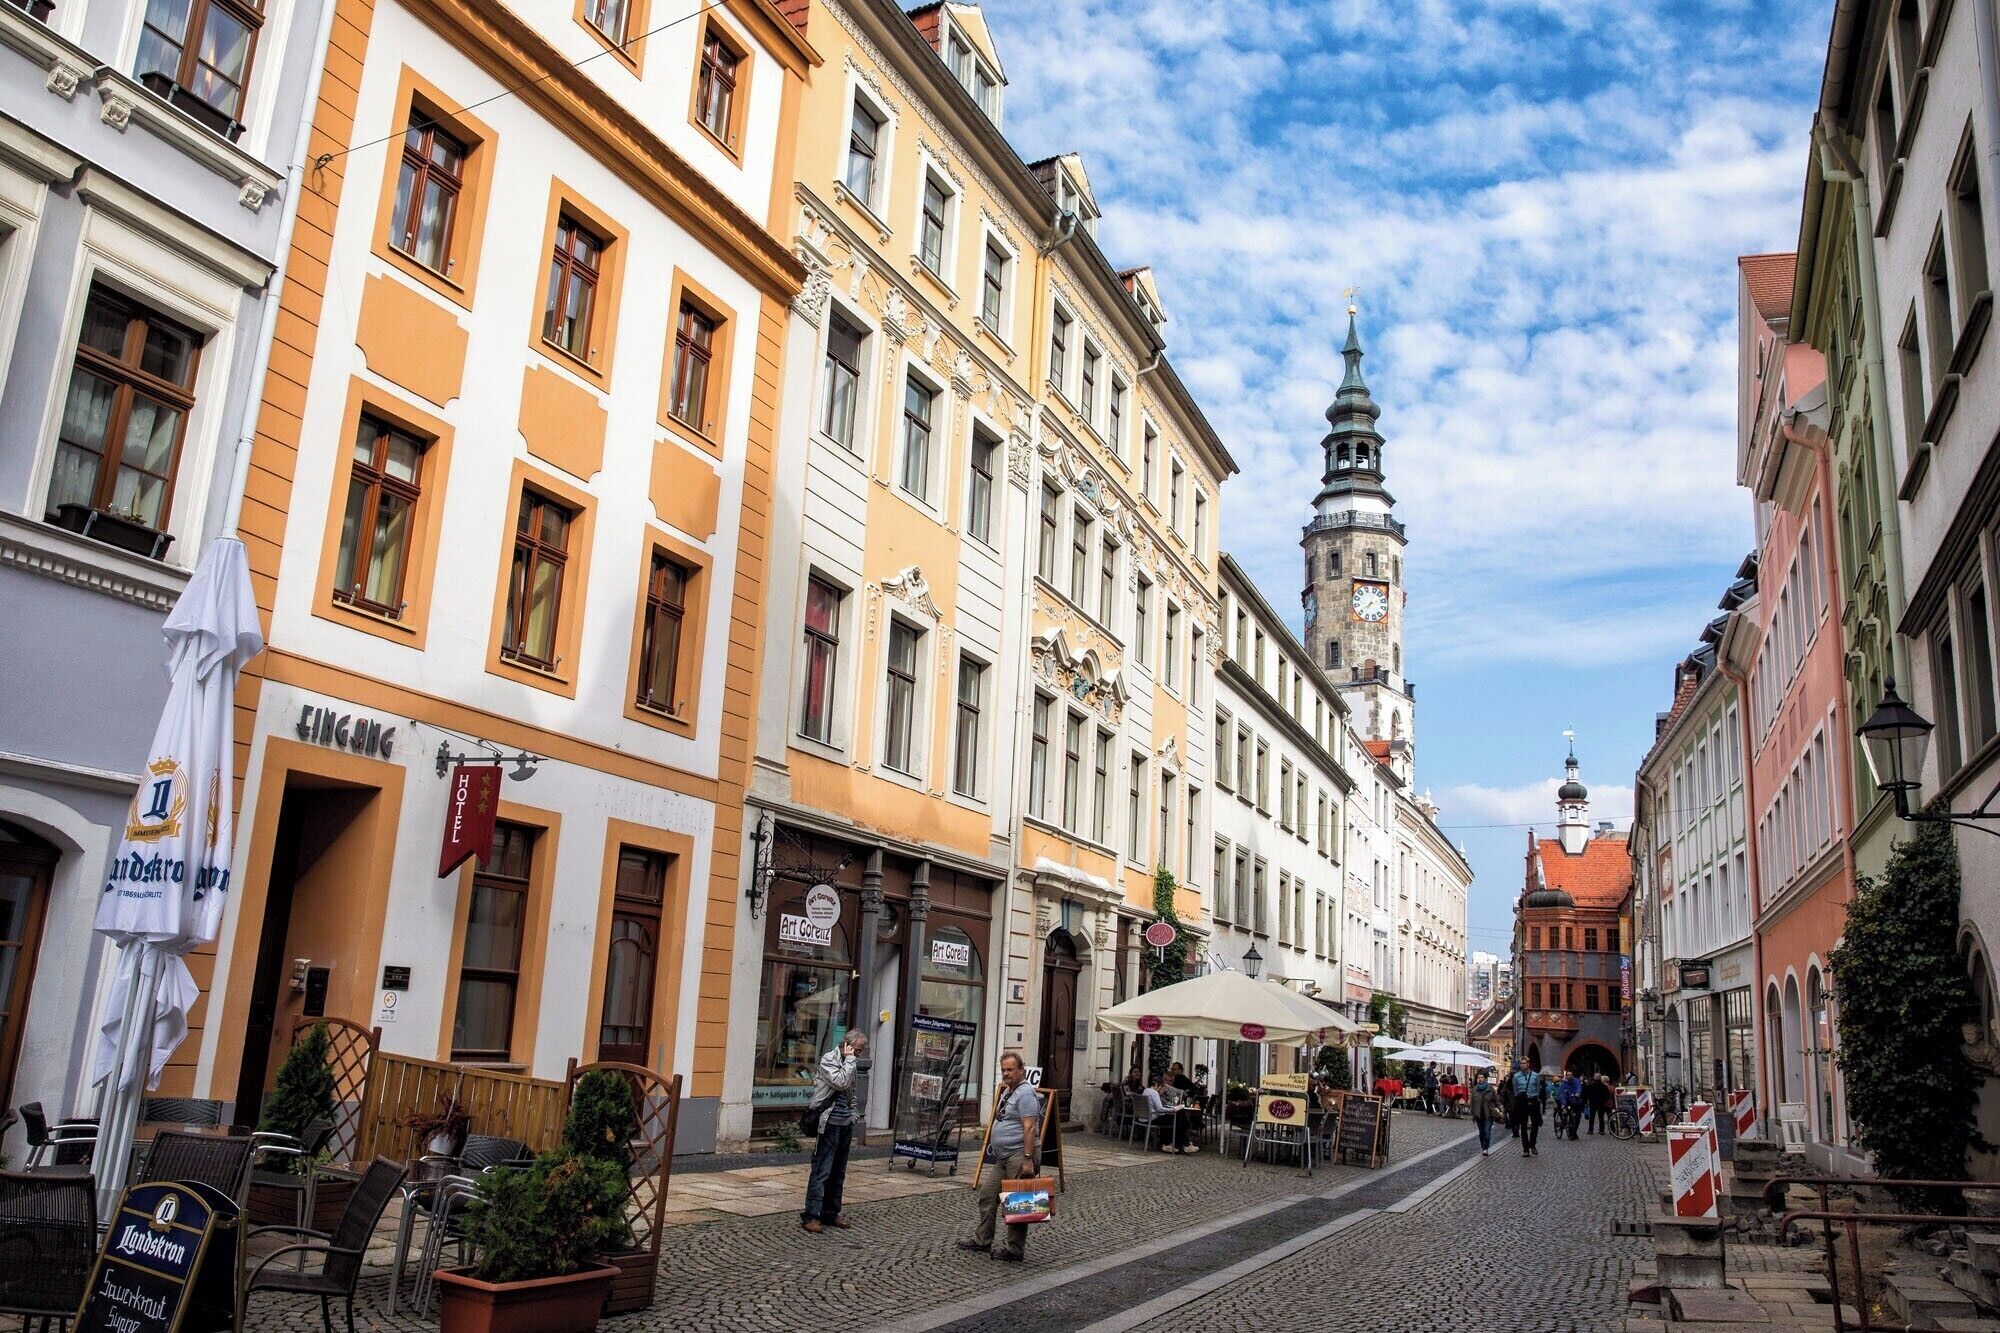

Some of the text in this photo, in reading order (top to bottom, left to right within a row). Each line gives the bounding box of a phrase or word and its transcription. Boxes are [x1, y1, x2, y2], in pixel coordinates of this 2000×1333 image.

[296, 704, 396, 760] EINGANG
[451, 774, 470, 843] HOTEL
[781, 916, 797, 936] Art
[933, 942, 944, 958] Art
[1621, 970, 1631, 1000] Achtung
[1262, 1079, 1306, 1090] Ferienwohnung
[116, 1224, 186, 1265] Landskron
[99, 1268, 168, 1320] Sauerkraut
